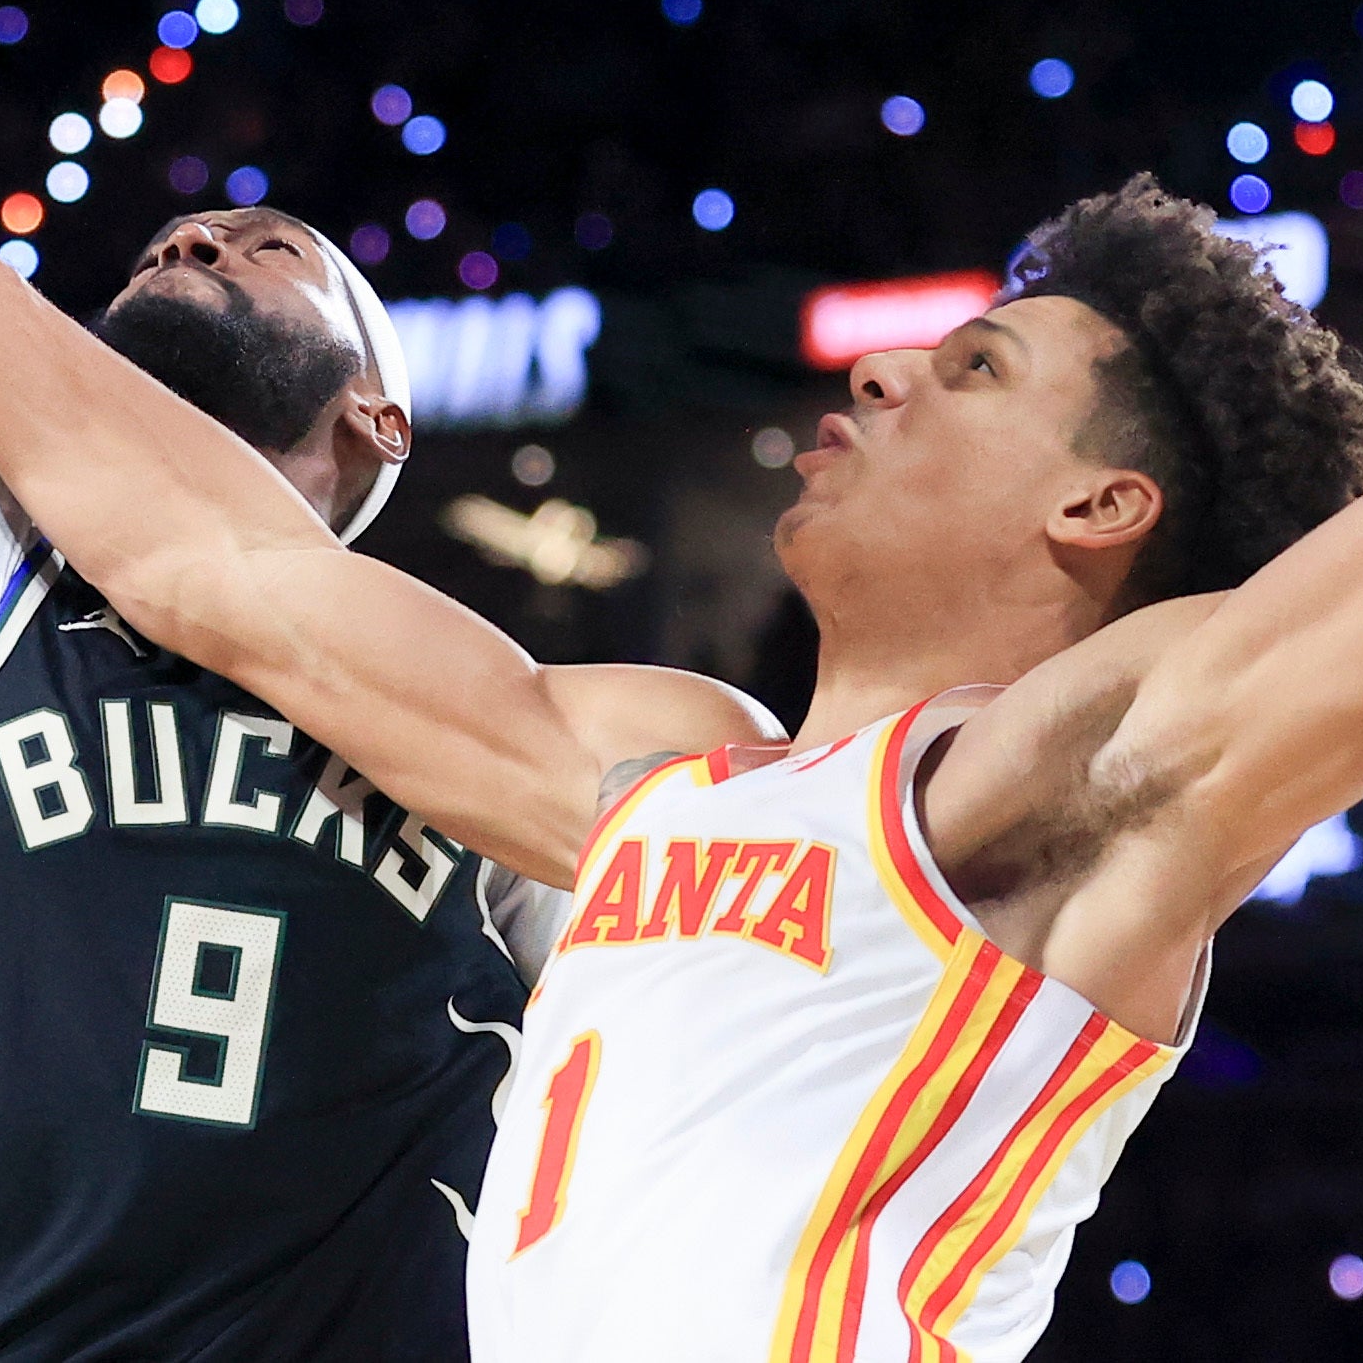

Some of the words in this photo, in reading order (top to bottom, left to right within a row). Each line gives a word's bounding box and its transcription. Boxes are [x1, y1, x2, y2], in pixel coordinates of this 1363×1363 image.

[132, 895, 288, 1130] 9
[557, 838, 836, 975] ANTA
[507, 1029, 602, 1262] 1
